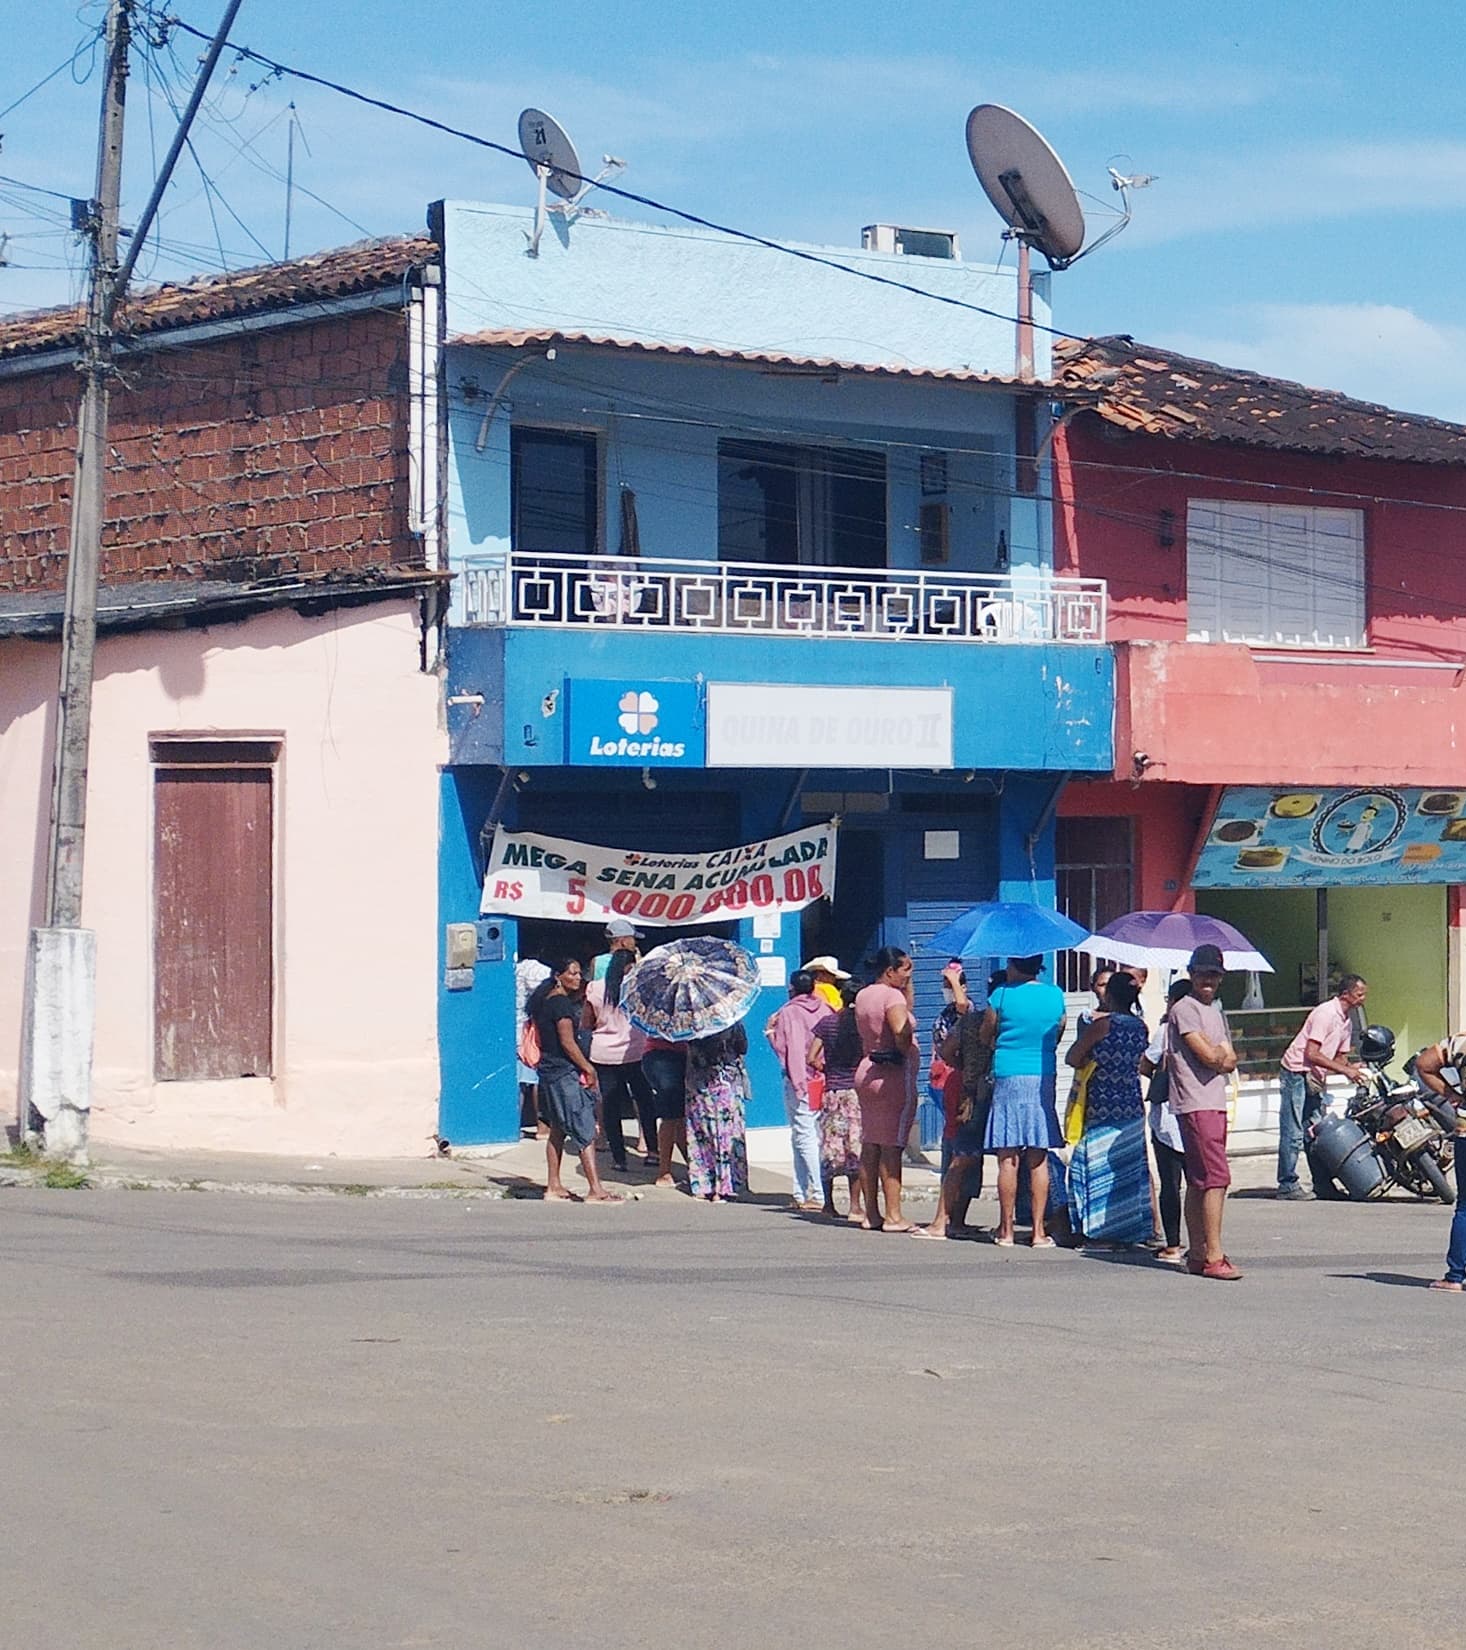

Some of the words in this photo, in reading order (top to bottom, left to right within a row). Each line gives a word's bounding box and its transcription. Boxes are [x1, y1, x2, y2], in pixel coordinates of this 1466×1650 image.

[721, 714, 800, 746] QUINA
[808, 714, 840, 746] DE
[847, 714, 912, 746] OURO
[914, 713, 943, 748] II
[589, 736, 686, 758] Loterias
[502, 843, 587, 877] MEGA
[596, 866, 676, 891] SENA
[640, 857, 699, 869] Loterias
[706, 842, 768, 869] CAIXA
[493, 879, 524, 901] R$
